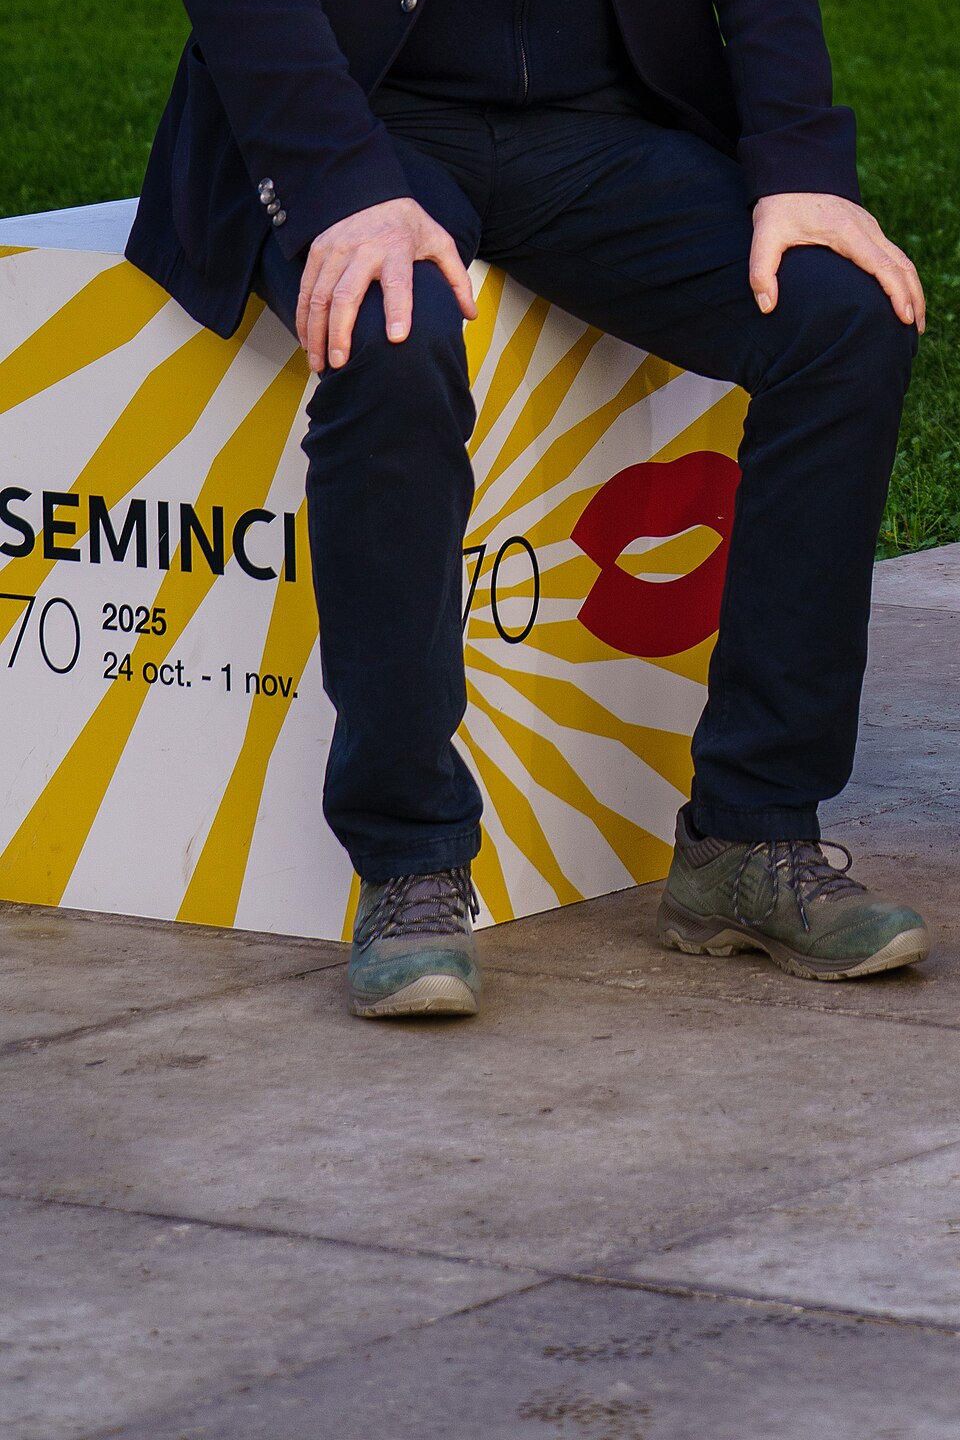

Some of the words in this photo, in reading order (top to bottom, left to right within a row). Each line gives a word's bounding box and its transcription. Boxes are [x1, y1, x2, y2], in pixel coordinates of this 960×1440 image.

[0, 486, 297, 582] SEMINCI
[102, 602, 167, 636] 2025
[462, 536, 540, 644] 70
[0, 592, 81, 674] 70
[103, 651, 133, 681] 24
[142, 660, 192, 687] oct.
[220, 663, 232, 691] 1
[245, 669, 299, 698] nov.
